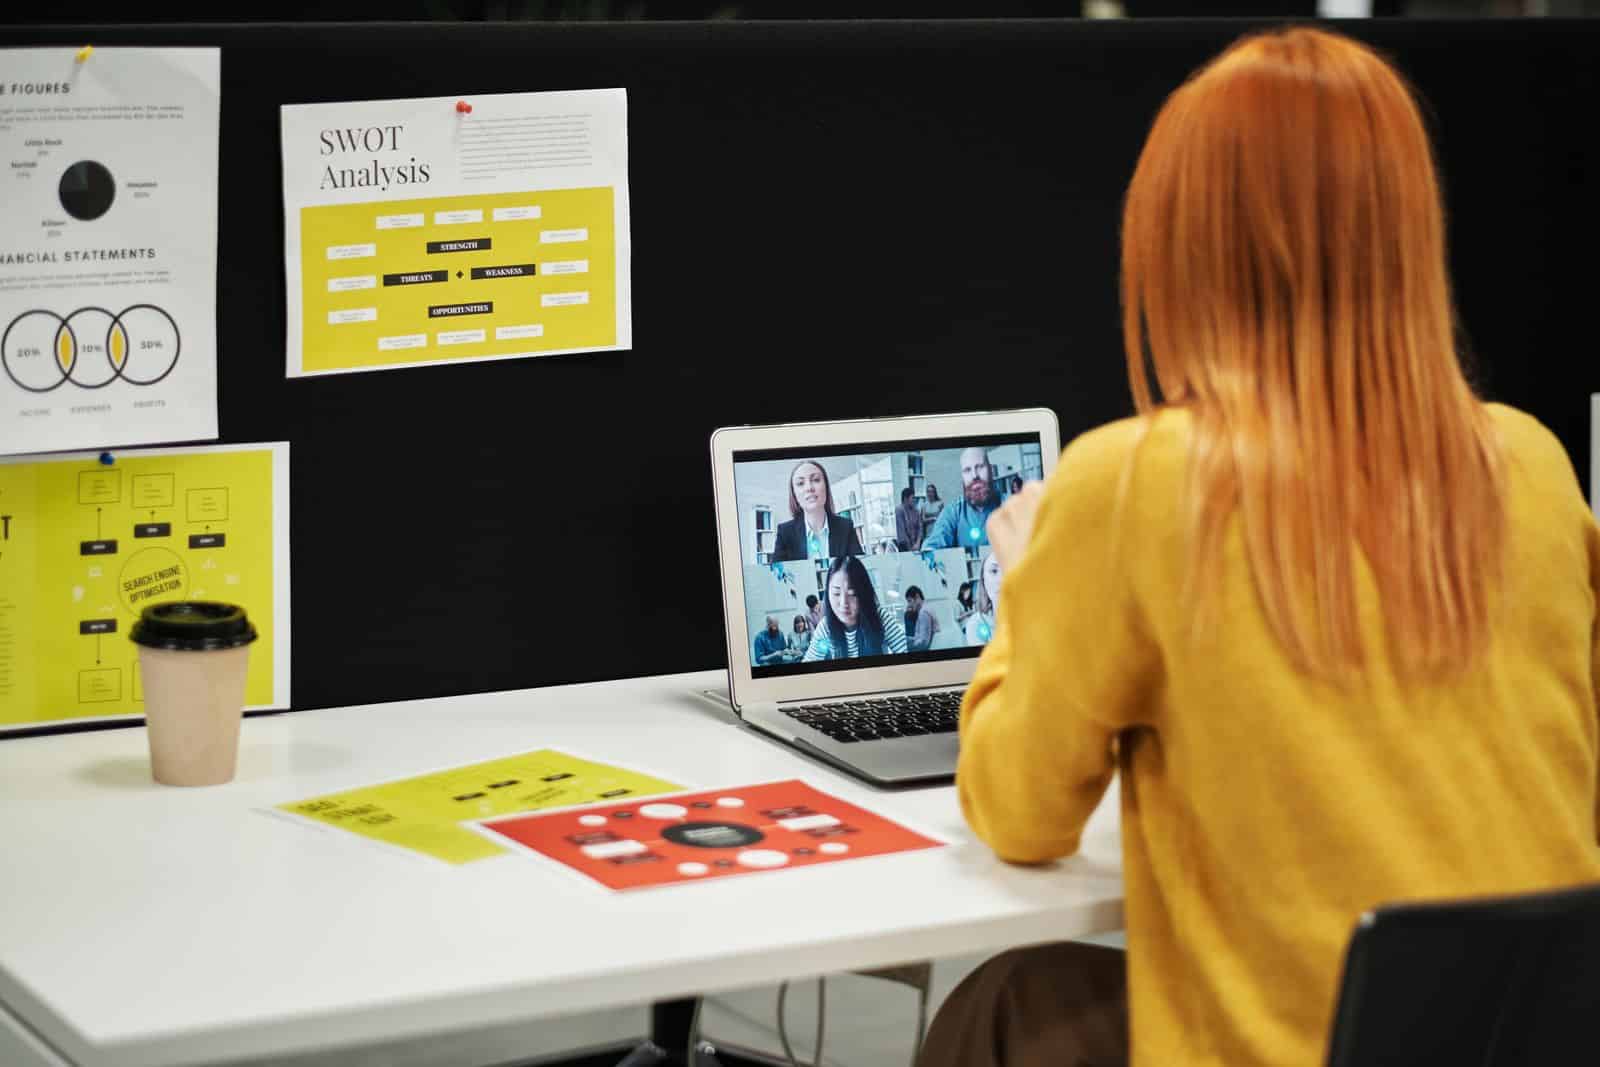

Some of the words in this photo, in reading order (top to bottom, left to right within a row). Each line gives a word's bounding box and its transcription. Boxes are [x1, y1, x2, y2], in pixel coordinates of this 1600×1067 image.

[11, 82, 70, 95] FIGURES
[320, 125, 404, 155] SWOT
[320, 157, 431, 191] Analysis
[440, 241, 478, 251] STRENGTH
[64, 248, 157, 262] STATEMENTS
[400, 273, 433, 283] THREATS
[484, 267, 523, 277] WEAKNESS
[432, 304, 489, 316] OPPORTUNITIES
[123, 574, 153, 592] SEARCH
[154, 565, 181, 583] ENGINE
[129, 579, 182, 603] OPTIMISATION
